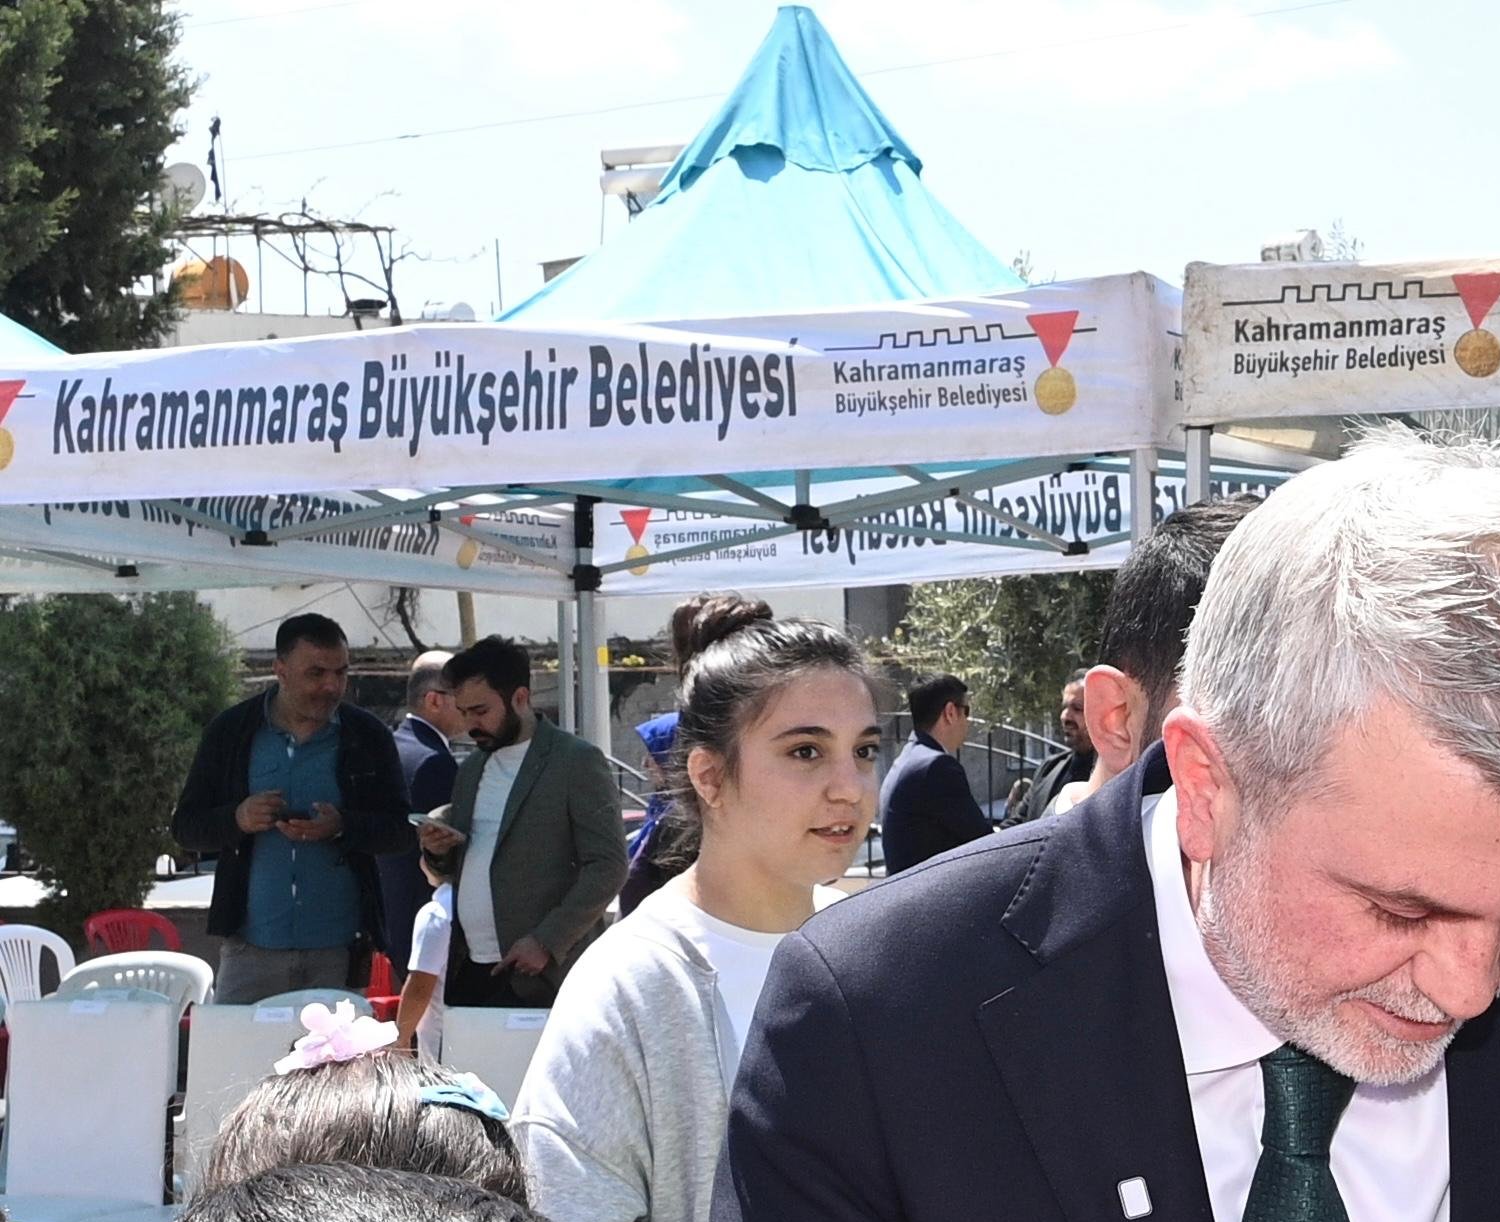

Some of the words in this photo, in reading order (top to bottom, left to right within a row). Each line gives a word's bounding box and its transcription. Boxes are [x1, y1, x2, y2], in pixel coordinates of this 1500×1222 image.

[1234, 315, 1446, 343] Kahramanmaraş
[833, 355, 1026, 384] Kahramanmaraş
[1233, 348, 1340, 378] Büyükşehir
[1345, 343, 1446, 371] Belediyesi
[52, 376, 351, 454] Kahramanmaraş
[358, 347, 579, 457] Büyükşehir
[588, 337, 798, 441] Belediyesi
[835, 387, 933, 417] Büyükşehir
[937, 380, 1028, 409] Belediyesi
